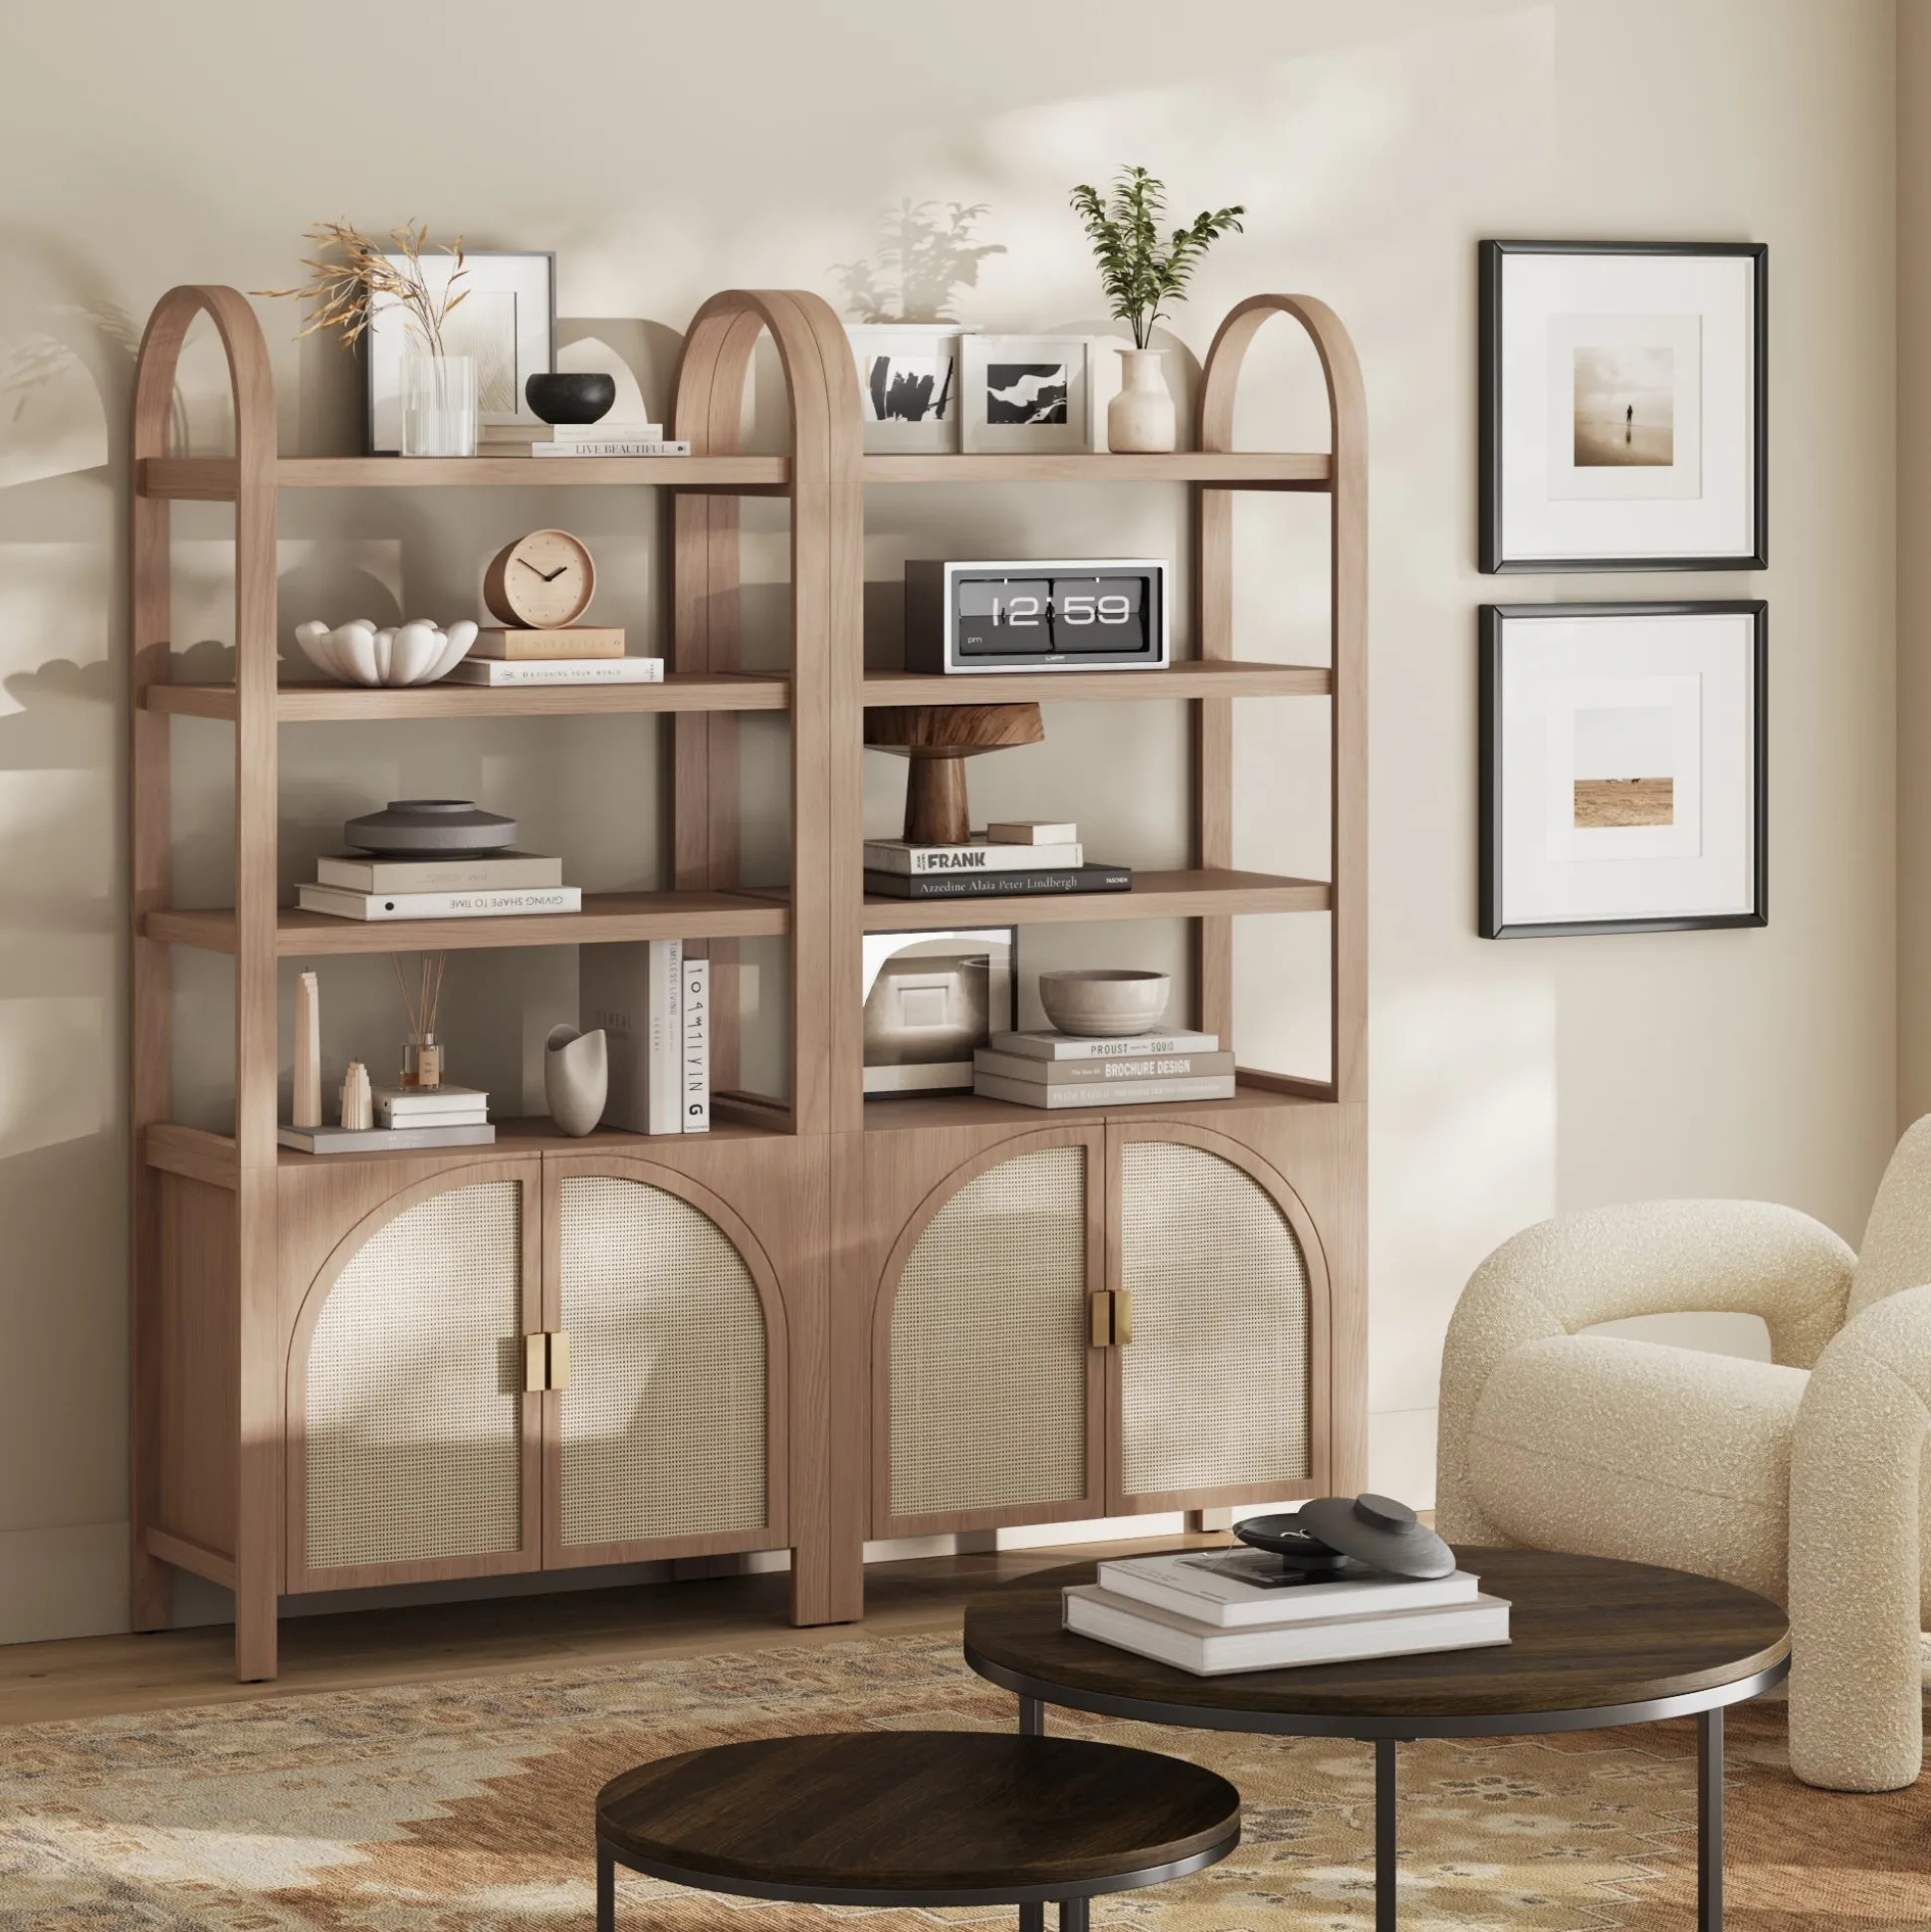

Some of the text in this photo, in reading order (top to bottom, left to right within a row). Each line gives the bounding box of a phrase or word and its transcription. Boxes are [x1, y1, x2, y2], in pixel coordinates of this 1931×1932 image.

[575, 444, 601, 455] LIVE
[604, 444, 668, 454] BEAUTIFUL
[967, 635, 982, 644] pm
[927, 851, 986, 869] FRANK
[920, 880, 966, 893] Azzedine
[998, 878, 1023, 890] Peter
[1027, 877, 1078, 891] Lindbergh
[449, 895, 563, 909] GIVING SHAPE TO TIME
[1090, 1043, 1128, 1055] PROUST
[1151, 1041, 1175, 1052] SQUID
[1105, 1061, 1155, 1078] BROCHURE
[1157, 1059, 1190, 1075] DESIGN
